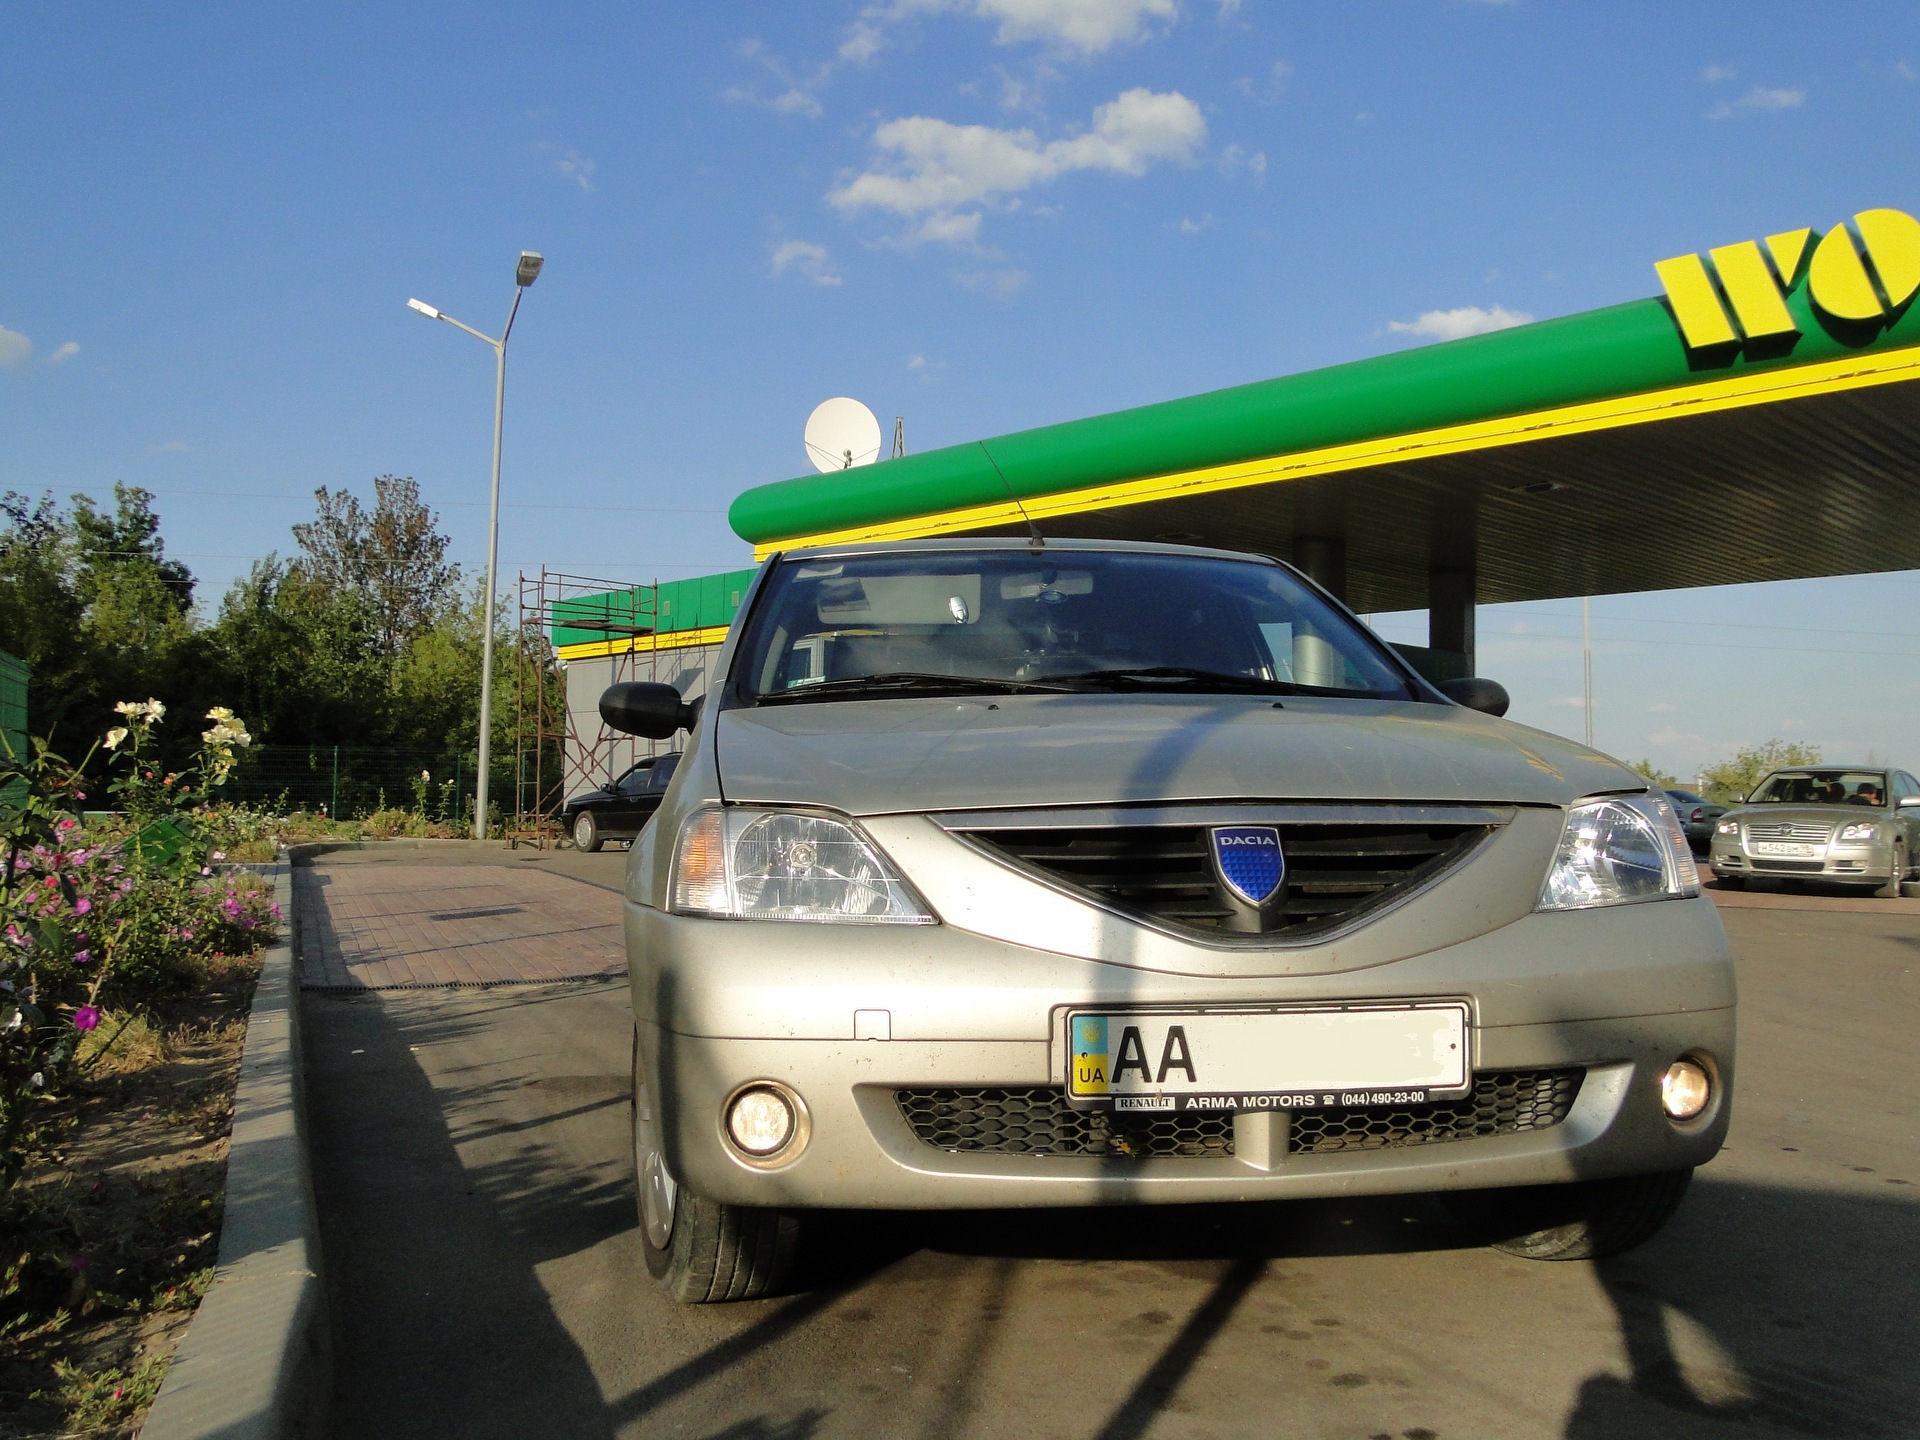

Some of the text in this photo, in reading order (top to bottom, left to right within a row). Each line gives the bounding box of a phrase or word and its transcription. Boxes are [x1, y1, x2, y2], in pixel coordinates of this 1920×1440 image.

[1219, 836, 1276, 847] DACIA
[1079, 1067, 1106, 1083] UA
[1120, 1098, 1171, 1108] RENAULT
[1185, 1097, 1238, 1109] ARMA
[1242, 1095, 1316, 1108] MOTORS
